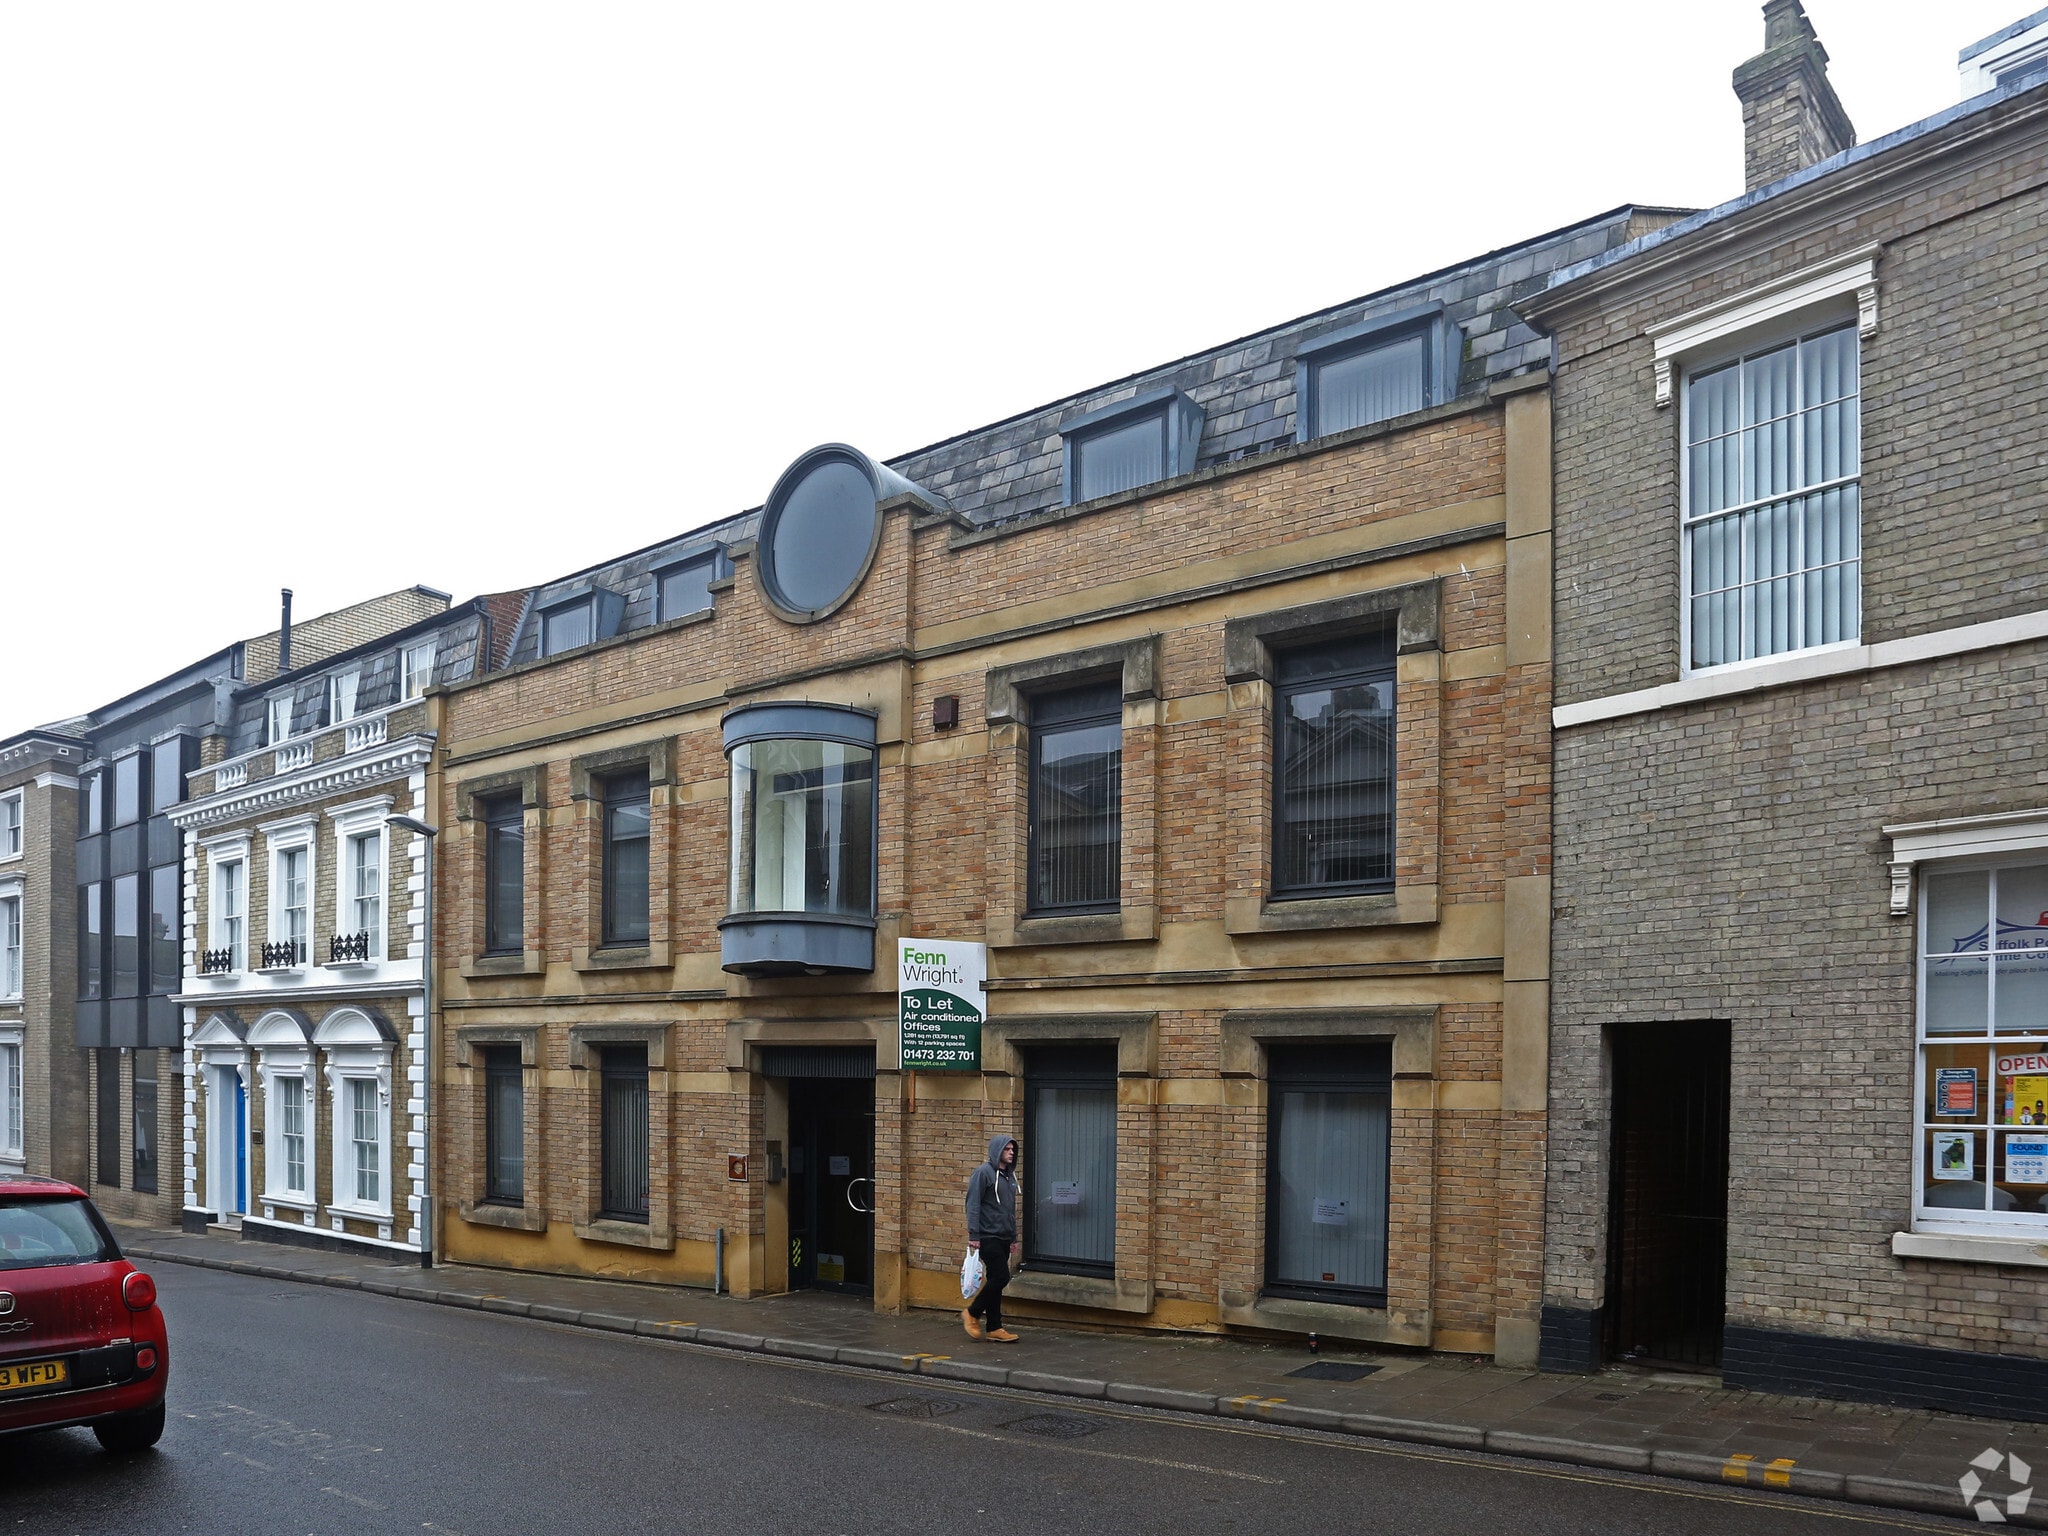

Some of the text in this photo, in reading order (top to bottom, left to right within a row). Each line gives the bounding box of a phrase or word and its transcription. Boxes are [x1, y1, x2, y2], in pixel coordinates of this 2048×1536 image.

[1979, 939, 2030, 951] Sffolk
[904, 947, 946, 965] Fenn
[903, 996, 953, 1010] To Let
[904, 1011, 979, 1022] Air conditioned
[904, 1022, 941, 1031] Offices
[904, 1049, 975, 1061] 01473 232 701
[1999, 1056, 2048, 1071] OPEN
[2012, 1143, 2043, 1151] FOUND
[0, 1364, 57, 1385] 3 WFD
